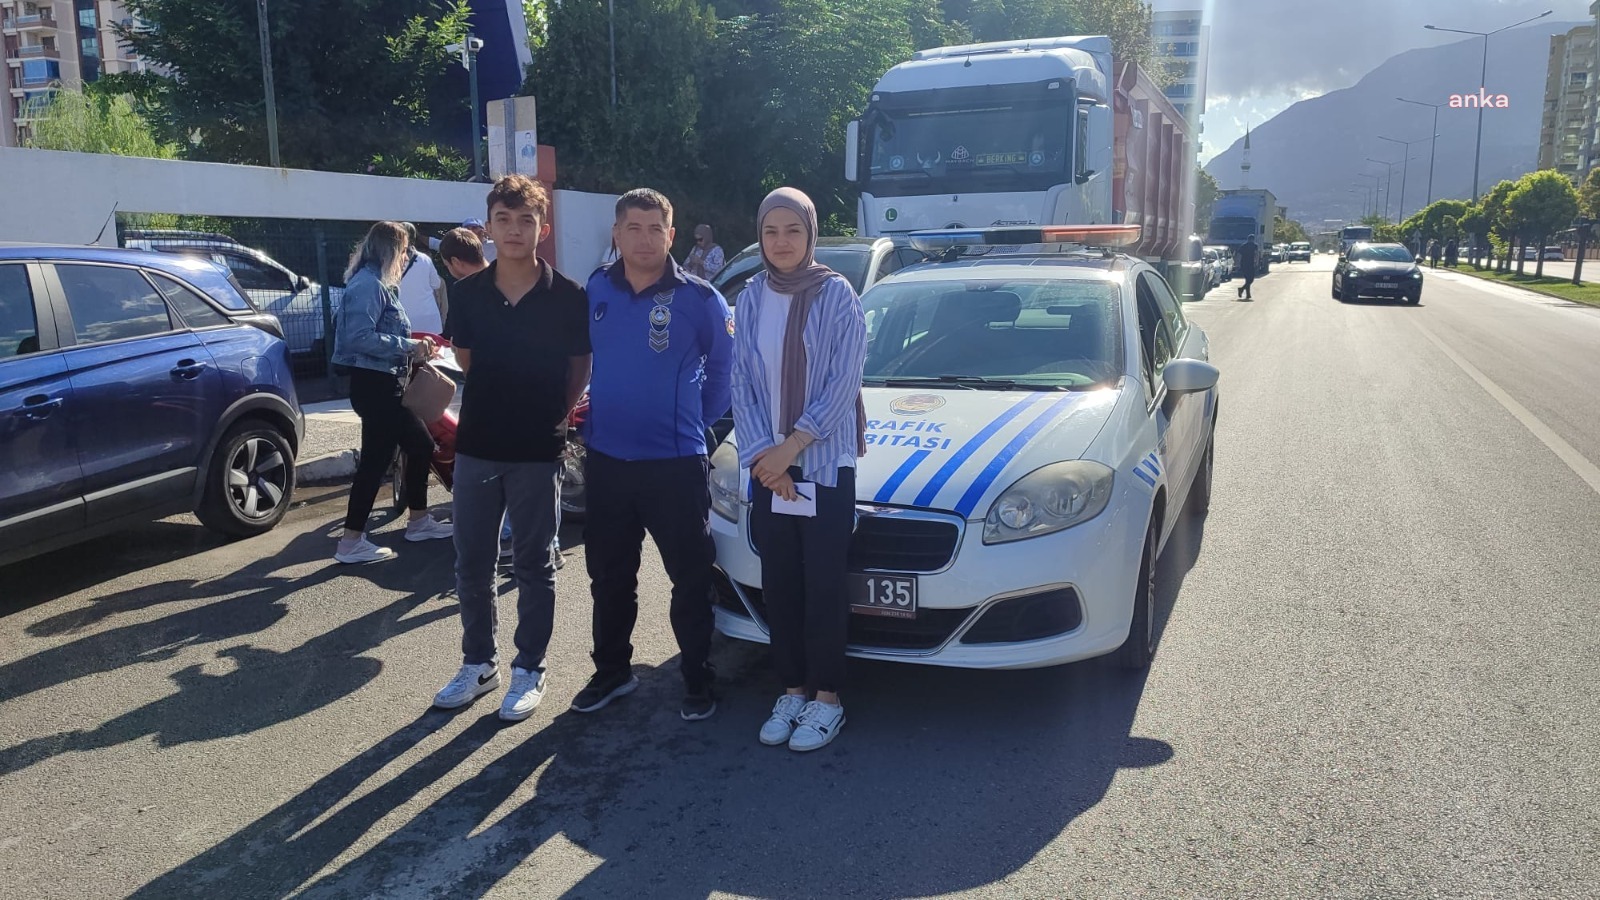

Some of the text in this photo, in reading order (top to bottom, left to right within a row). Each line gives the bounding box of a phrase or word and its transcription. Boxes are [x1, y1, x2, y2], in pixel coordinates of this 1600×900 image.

[888, 210, 895, 220] L
[866, 419, 947, 433] RAFİK
[864, 433, 952, 450] BITASI
[867, 578, 911, 606] 135
